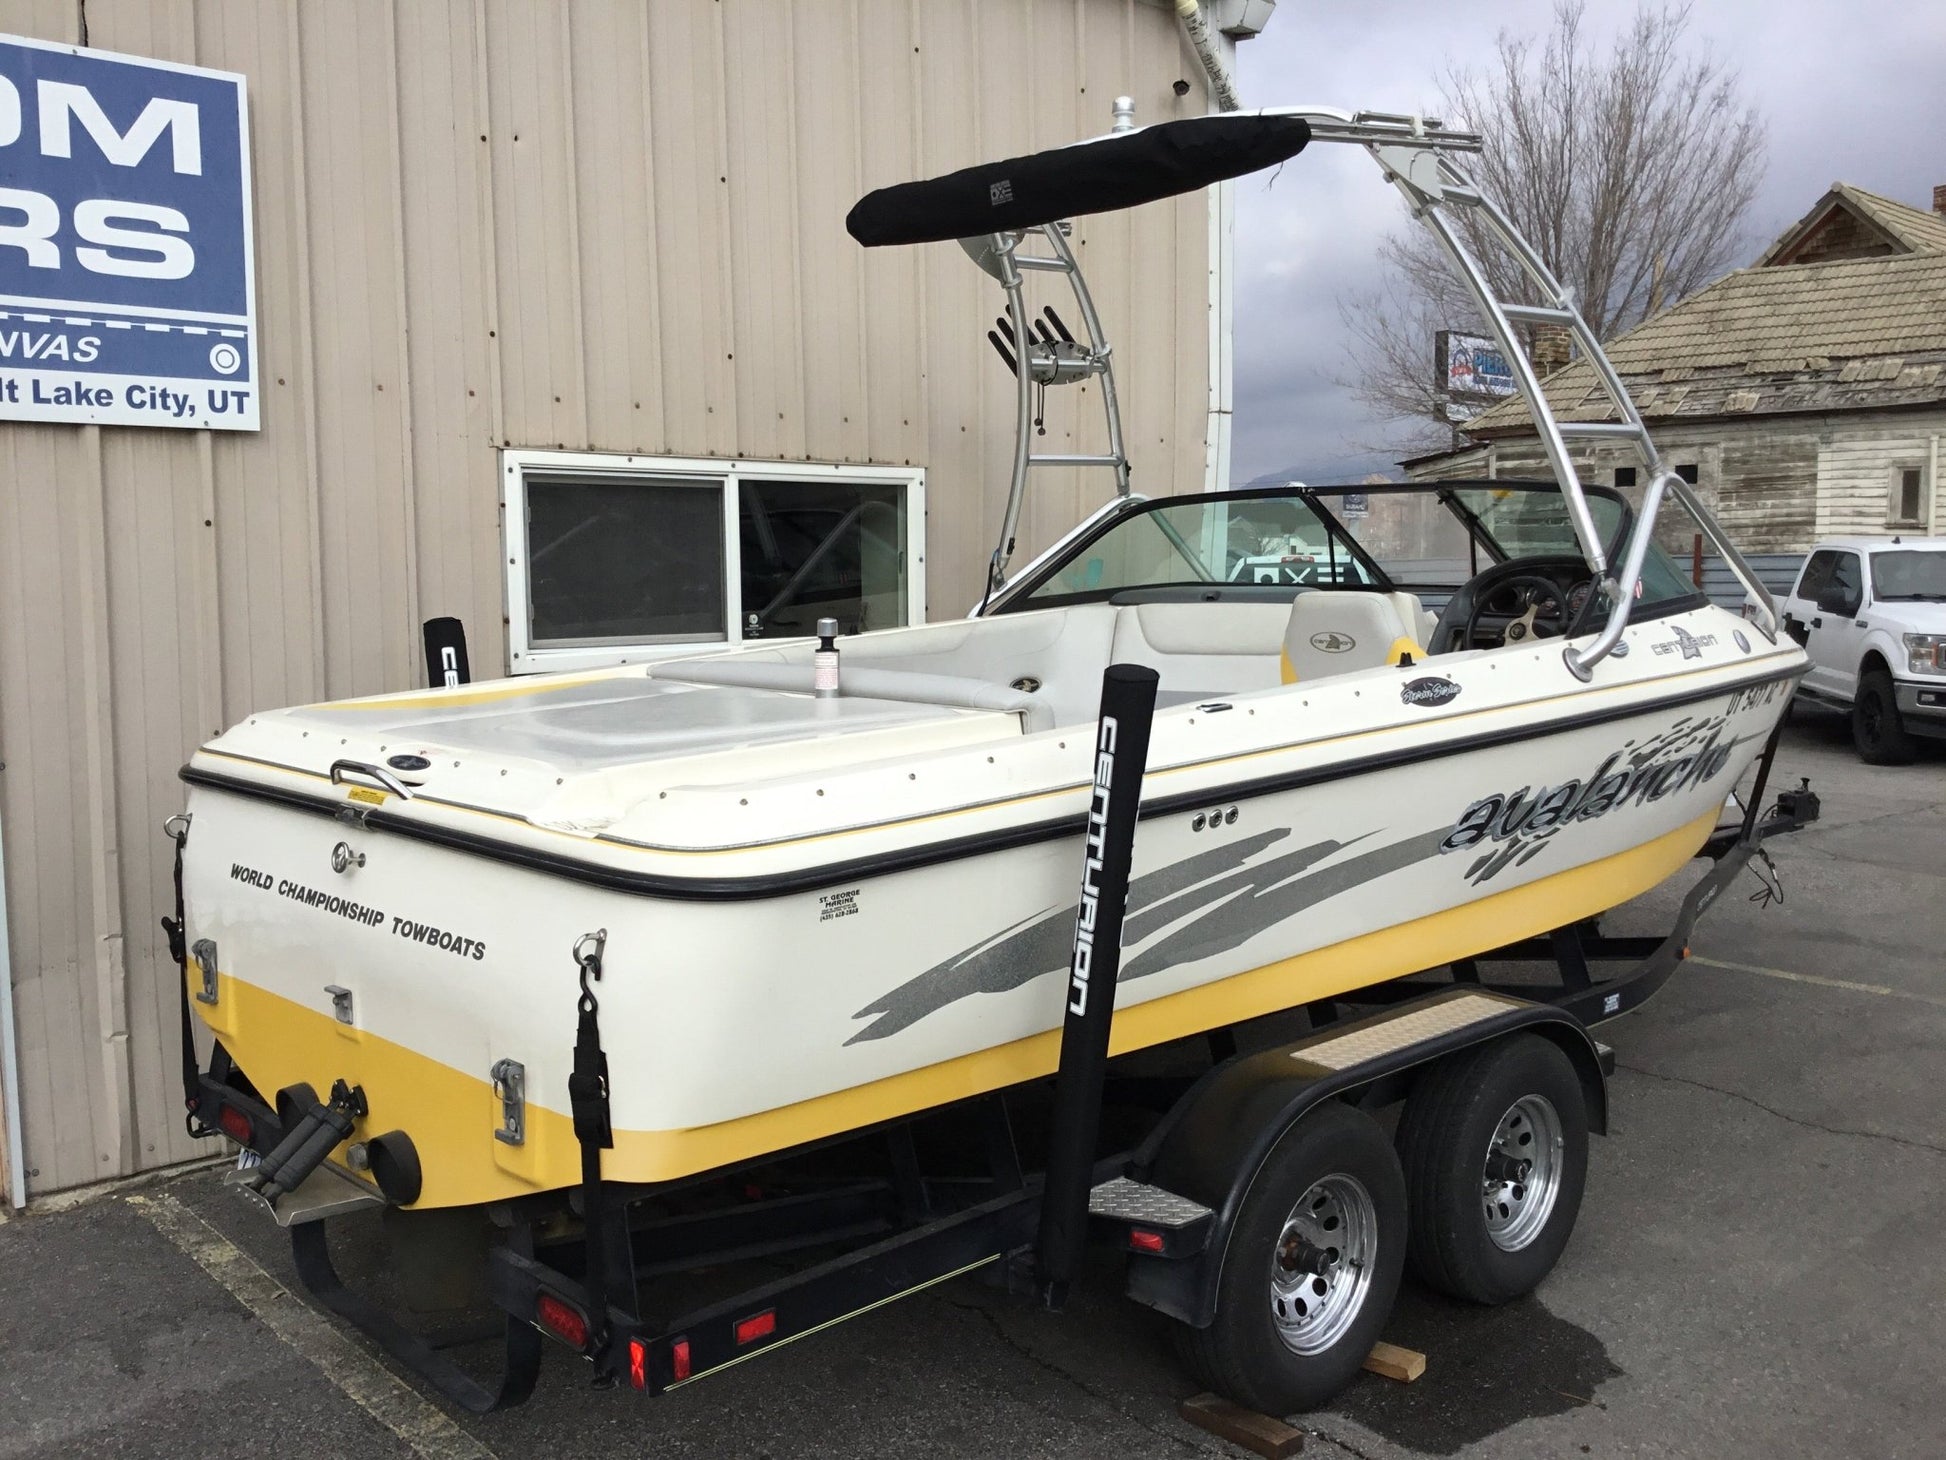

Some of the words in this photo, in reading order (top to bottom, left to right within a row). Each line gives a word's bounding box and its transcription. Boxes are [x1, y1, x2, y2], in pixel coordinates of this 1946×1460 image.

[0, 74, 202, 176] M
[32, 379, 113, 407] Lake
[126, 385, 195, 417] City,
[208, 389, 250, 414] UT
[830, 889, 860, 901] GEORGE
[1069, 715, 1118, 1017] CENTURION
[231, 863, 274, 890] WORLD
[278, 880, 385, 928] CHAMPIONSHIP
[391, 917, 486, 961] TOWBOATS
[825, 897, 854, 908] MARINE
